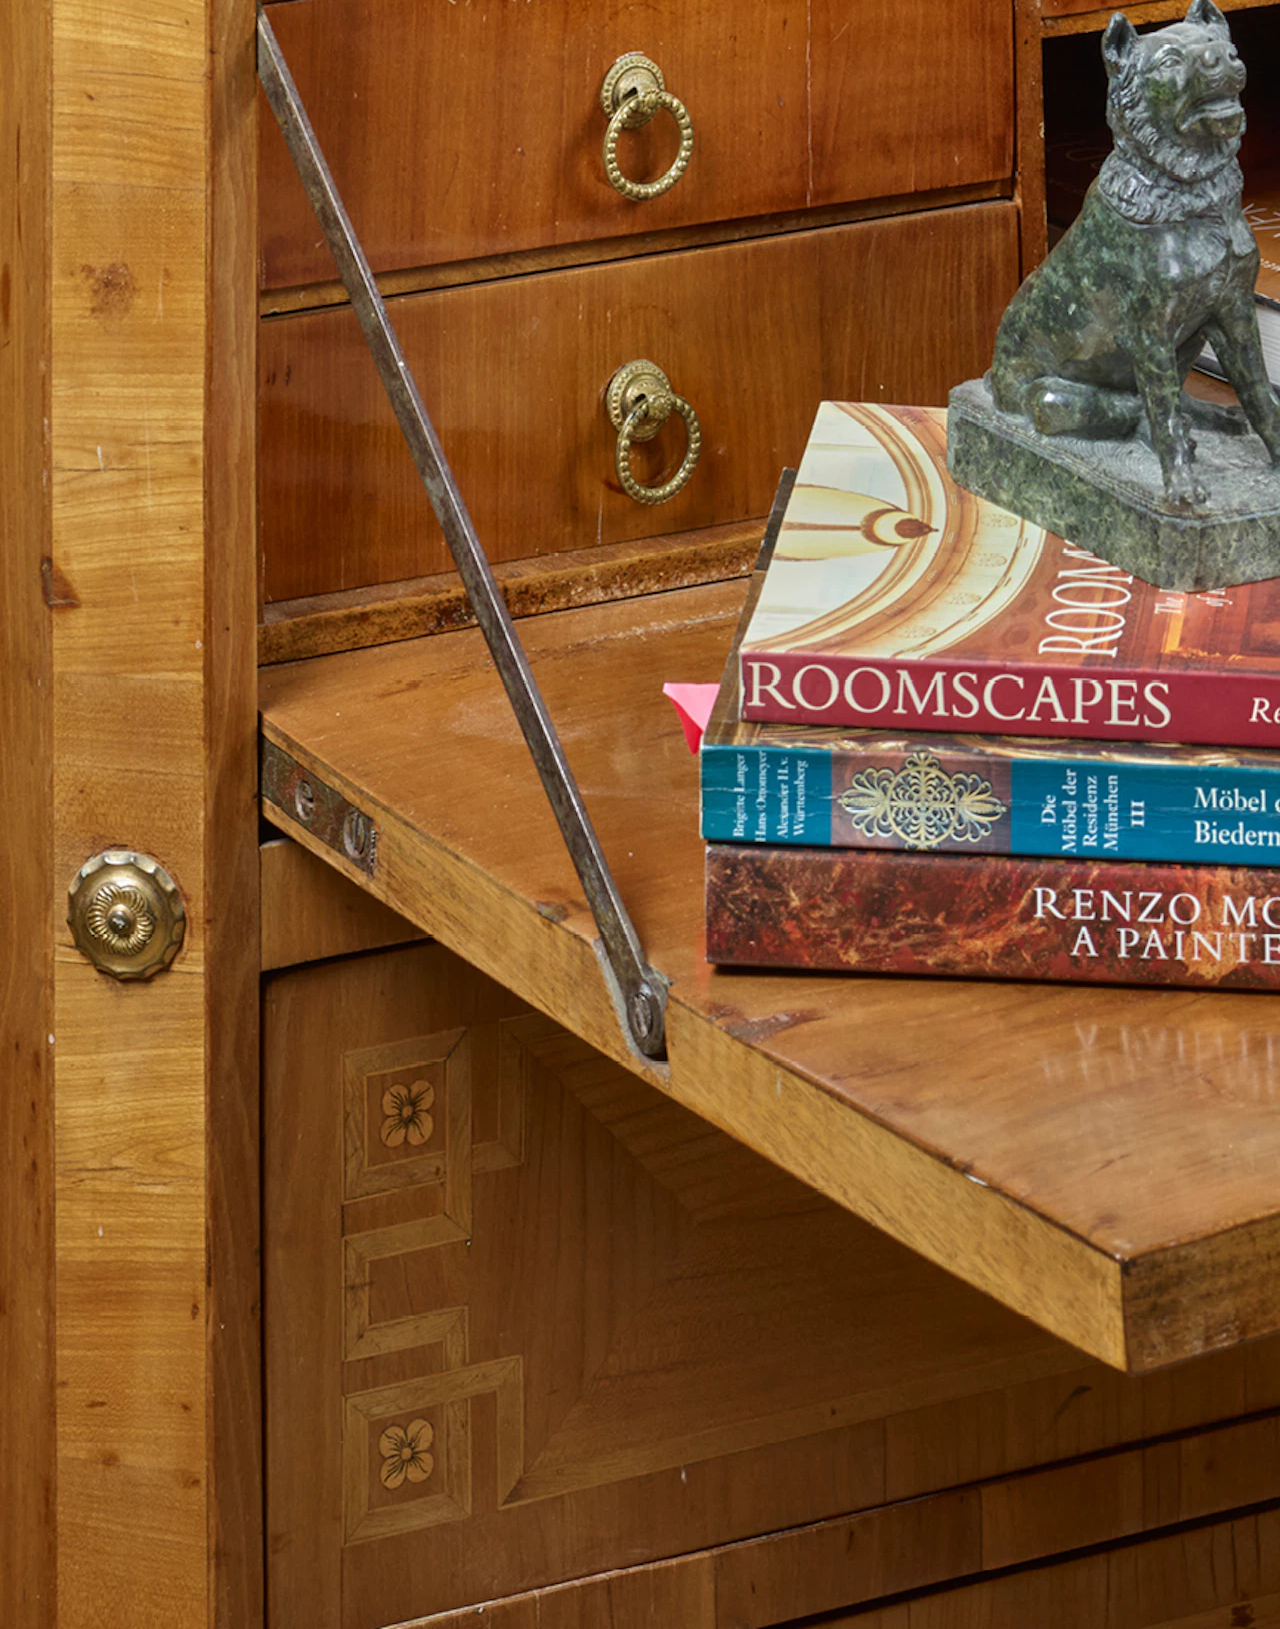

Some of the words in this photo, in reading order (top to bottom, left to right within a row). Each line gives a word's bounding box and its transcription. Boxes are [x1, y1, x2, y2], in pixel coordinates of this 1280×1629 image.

[747, 662, 1173, 731] ROOMSCAPES
[793, 759, 809, 836] Württemberg
[1061, 768, 1077, 796] der
[1041, 794, 1057, 824] Die
[1082, 775, 1098, 847] Residenz
[1103, 774, 1119, 852] München
[1130, 799, 1145, 827] III
[1193, 786, 1266, 820] Möbel
[1061, 800, 1077, 853] Möbel
[1033, 889, 1203, 928] RENZO
[1071, 927, 1100, 957] A
